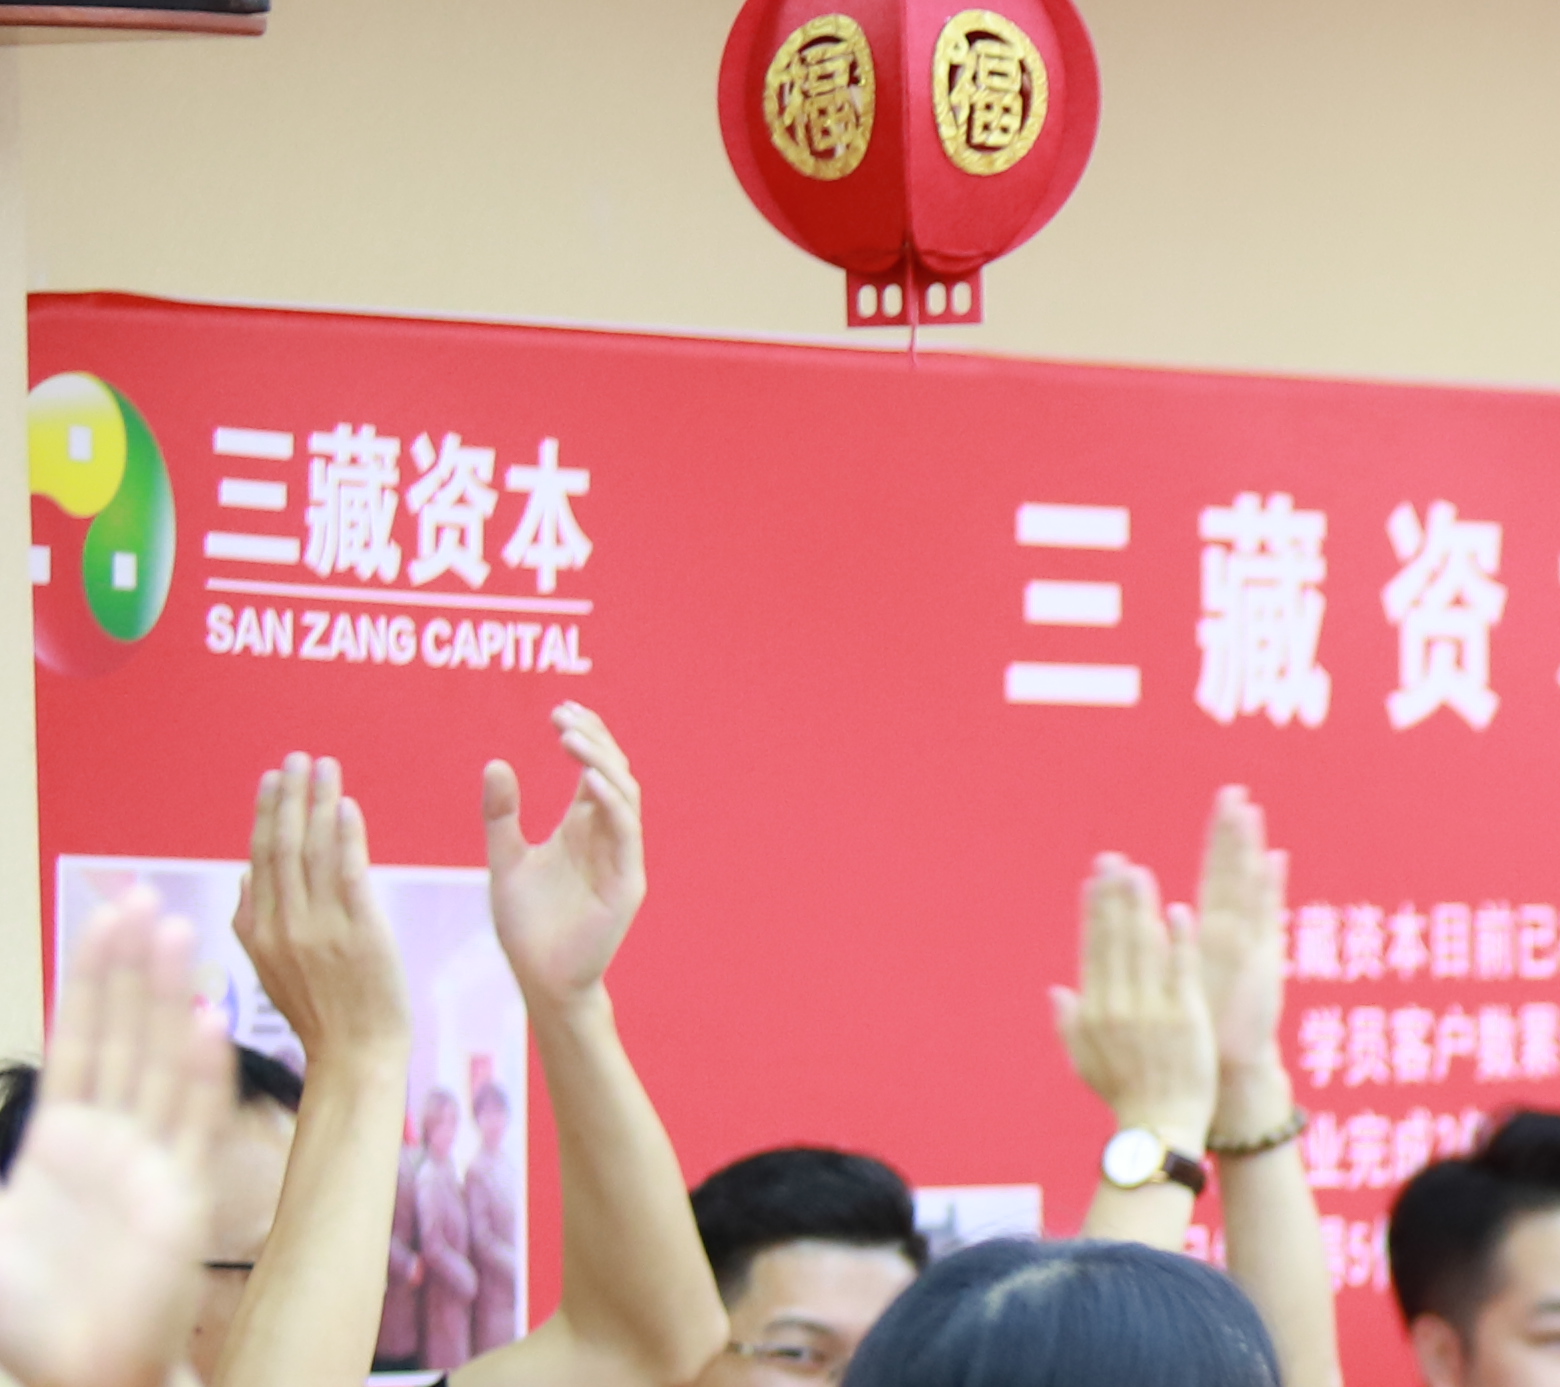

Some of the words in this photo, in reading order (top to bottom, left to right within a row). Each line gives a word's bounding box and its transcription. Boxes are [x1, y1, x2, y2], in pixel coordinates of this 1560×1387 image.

[203, 422, 593, 594] 三藏资本
[205, 604, 292, 657] SAN
[299, 610, 416, 668] ZANG
[421, 615, 592, 674] CAPITAL
